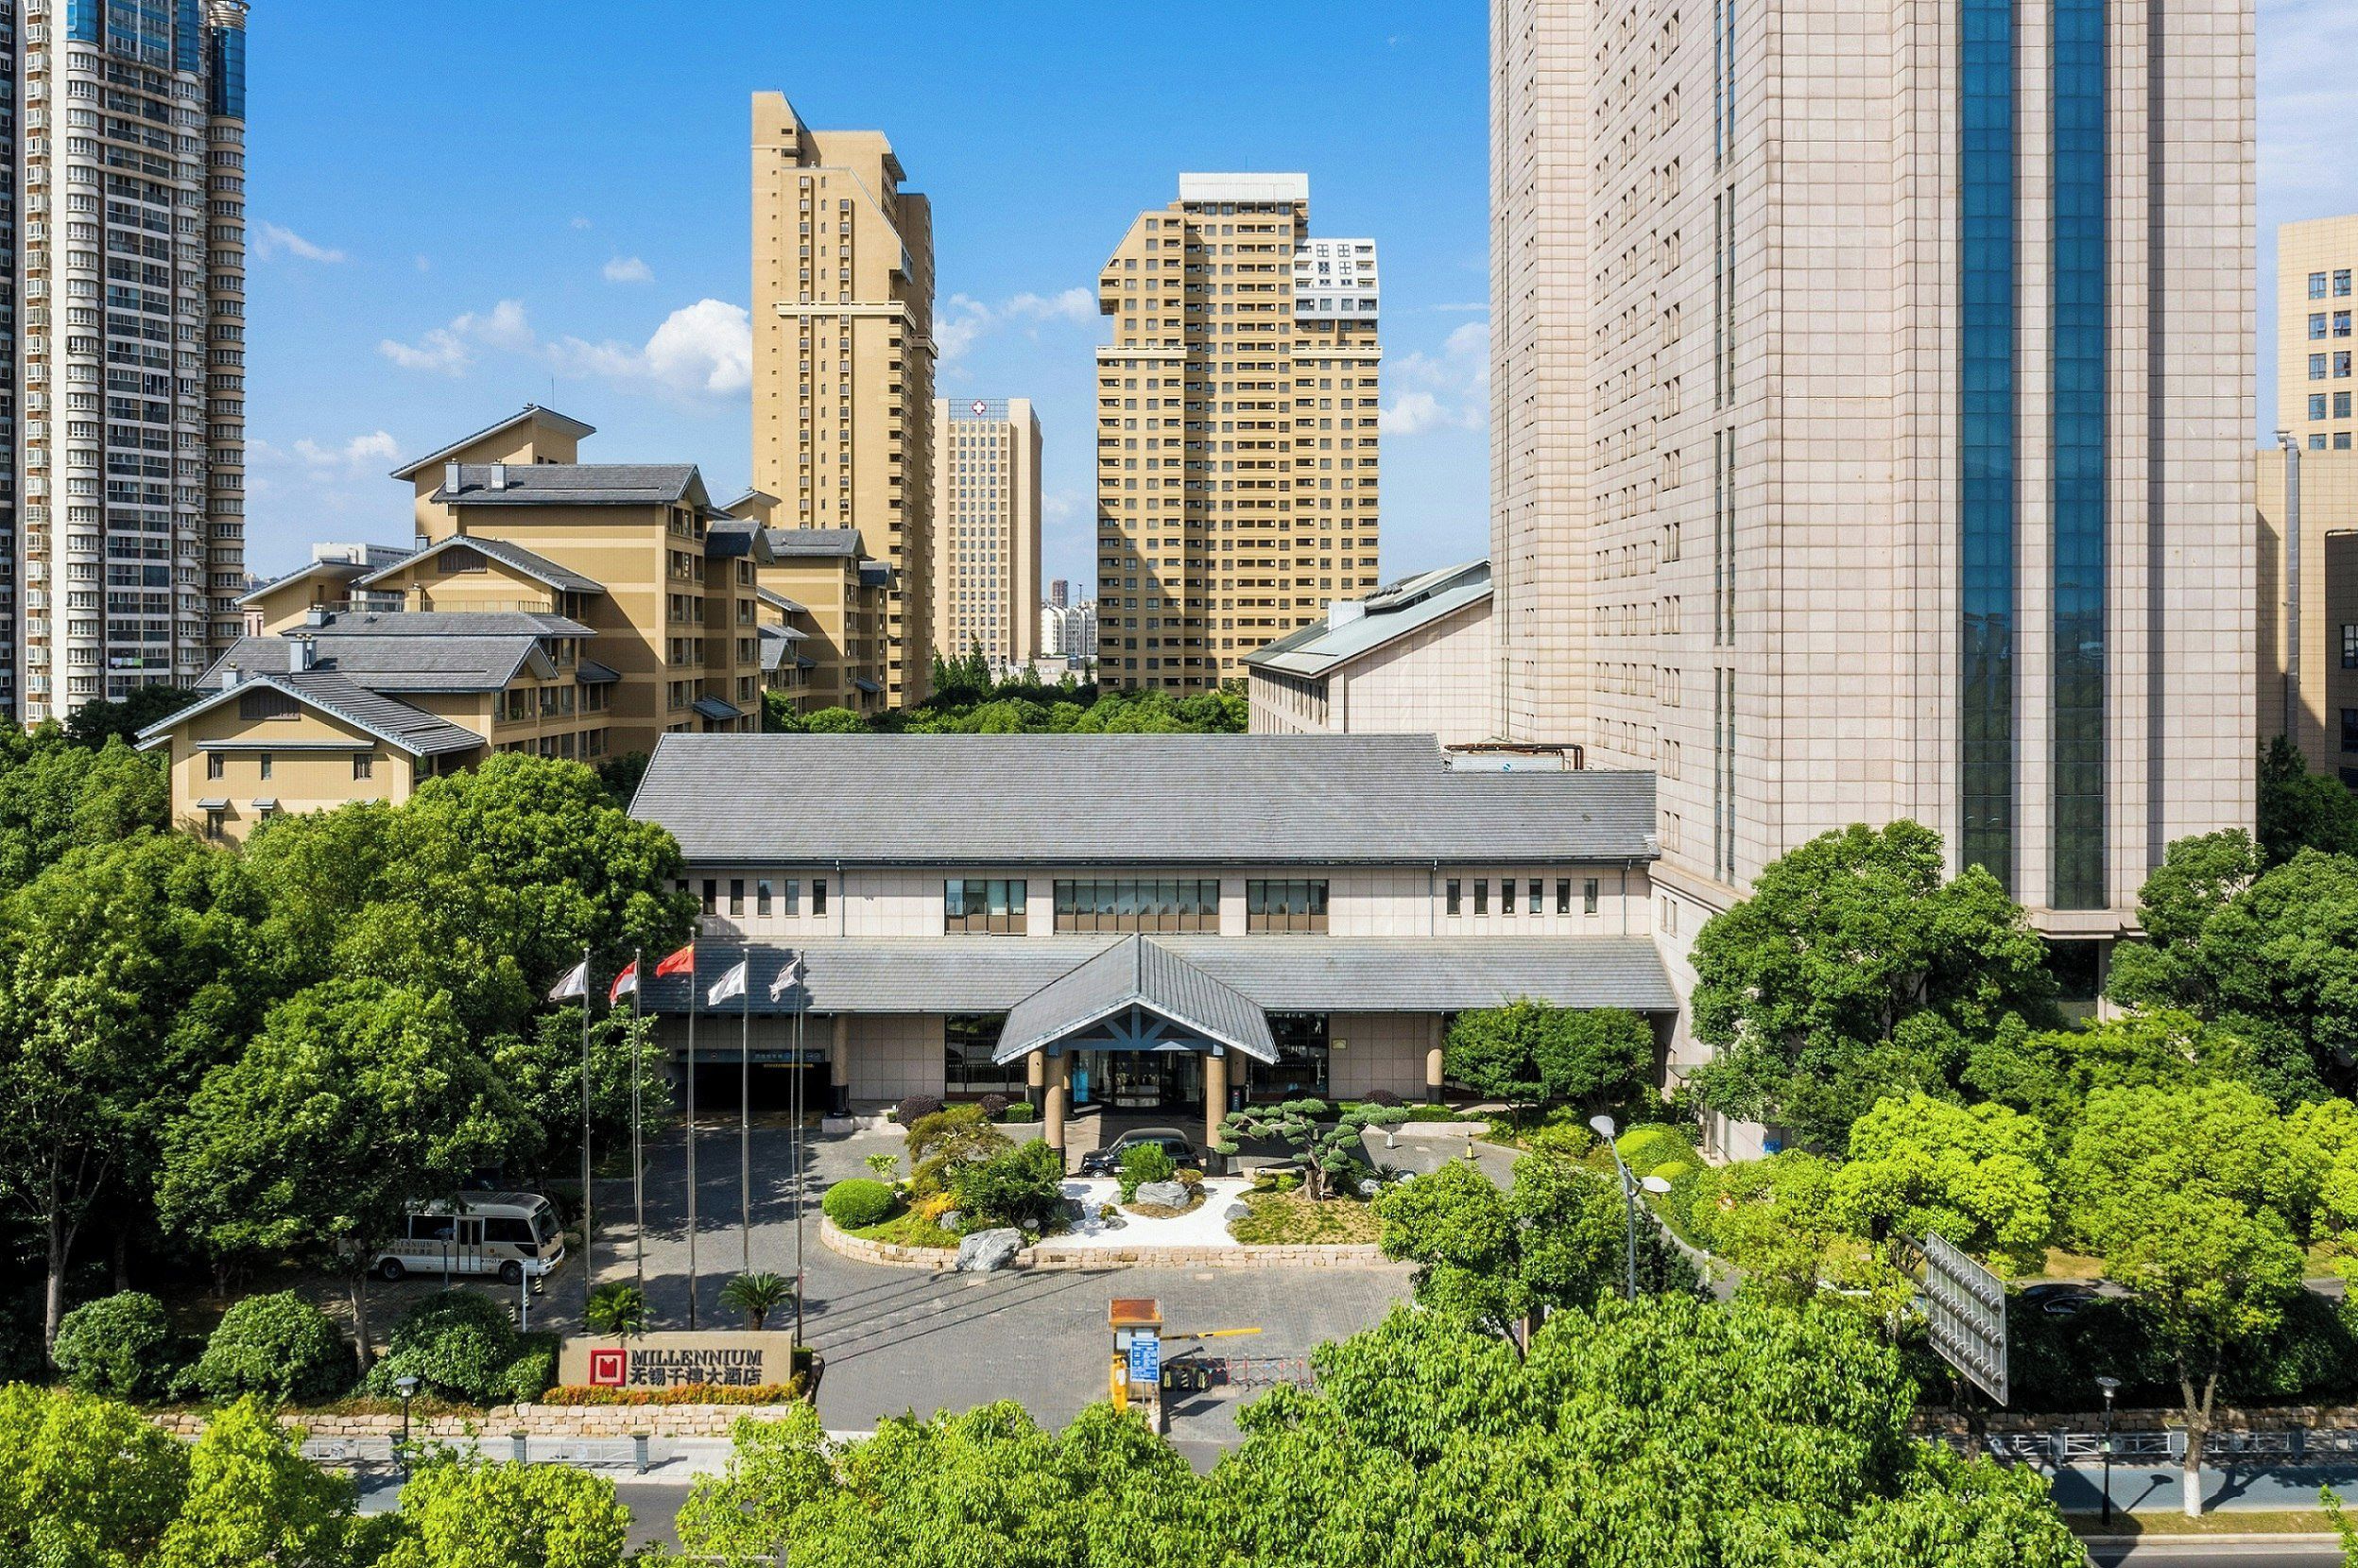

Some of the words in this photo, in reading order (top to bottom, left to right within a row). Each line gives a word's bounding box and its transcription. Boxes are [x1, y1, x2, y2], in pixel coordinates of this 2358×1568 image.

[630, 1349, 763, 1367] MILLENNIUM
[628, 1366, 763, 1387] 无锡千禧大酒店
